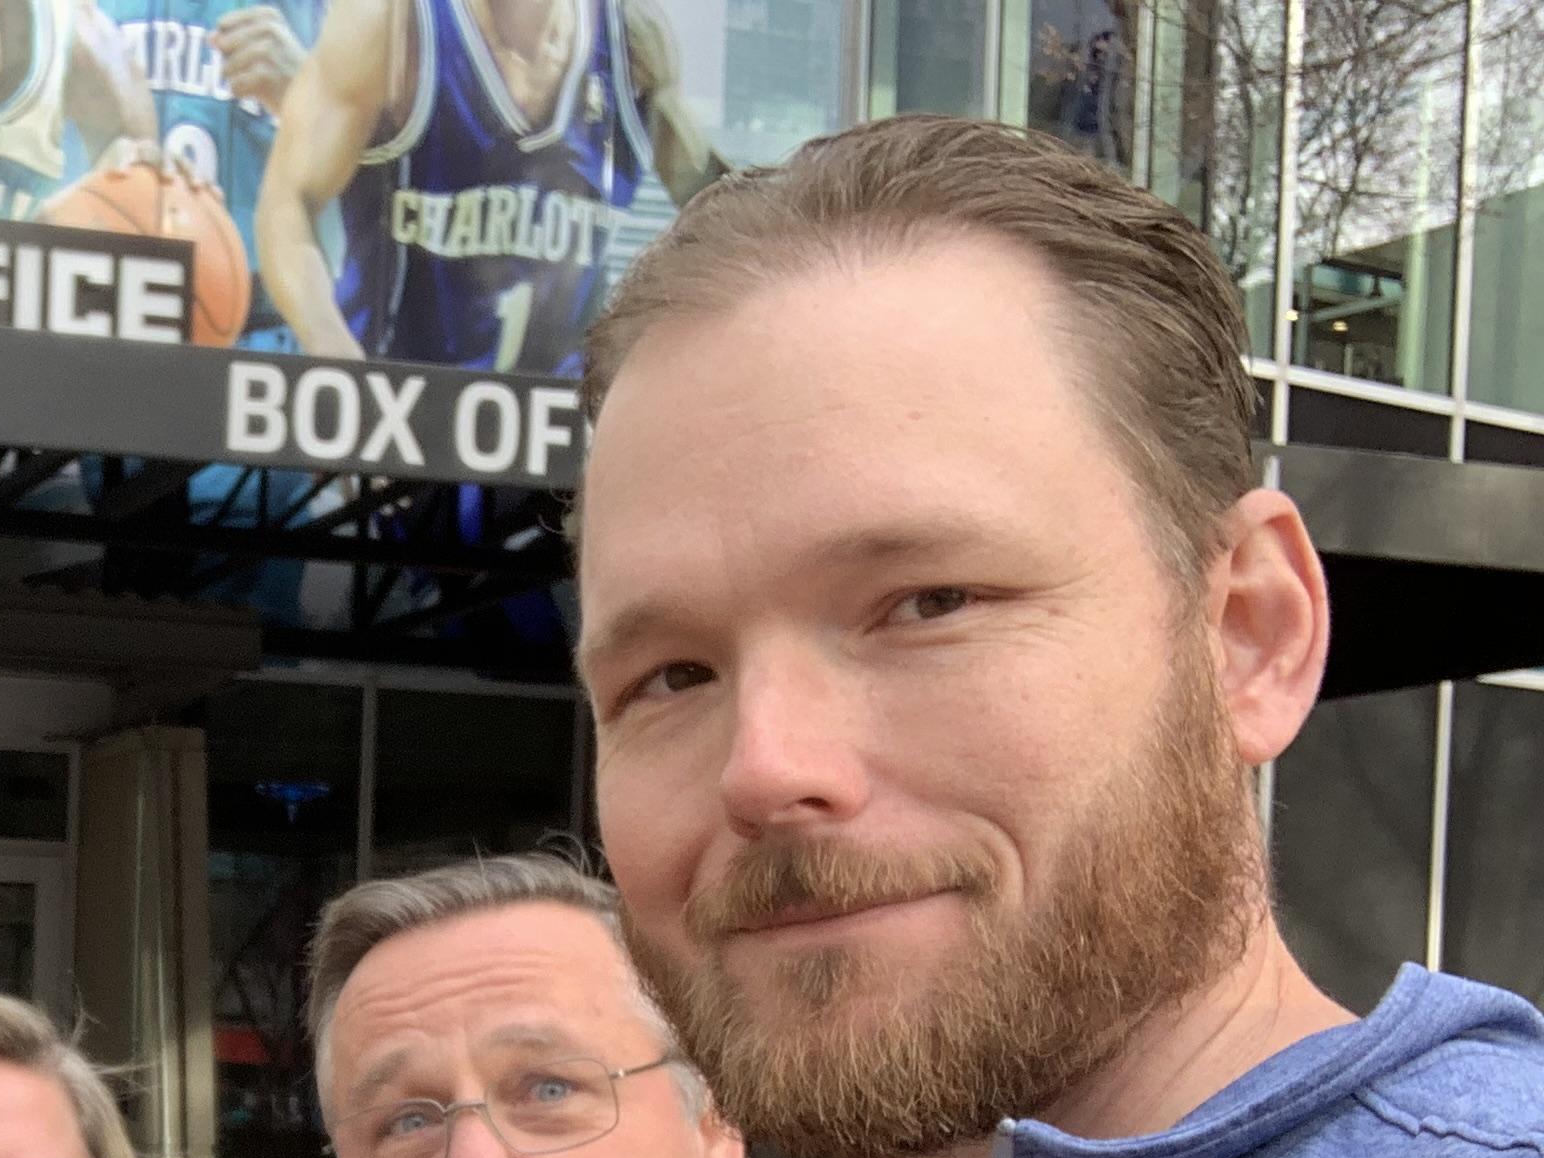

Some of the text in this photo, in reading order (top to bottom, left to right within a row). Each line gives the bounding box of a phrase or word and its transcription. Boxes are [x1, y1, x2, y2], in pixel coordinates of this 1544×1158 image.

[495, 280, 534, 373] 1
[226, 361, 593, 476] BOX OF
